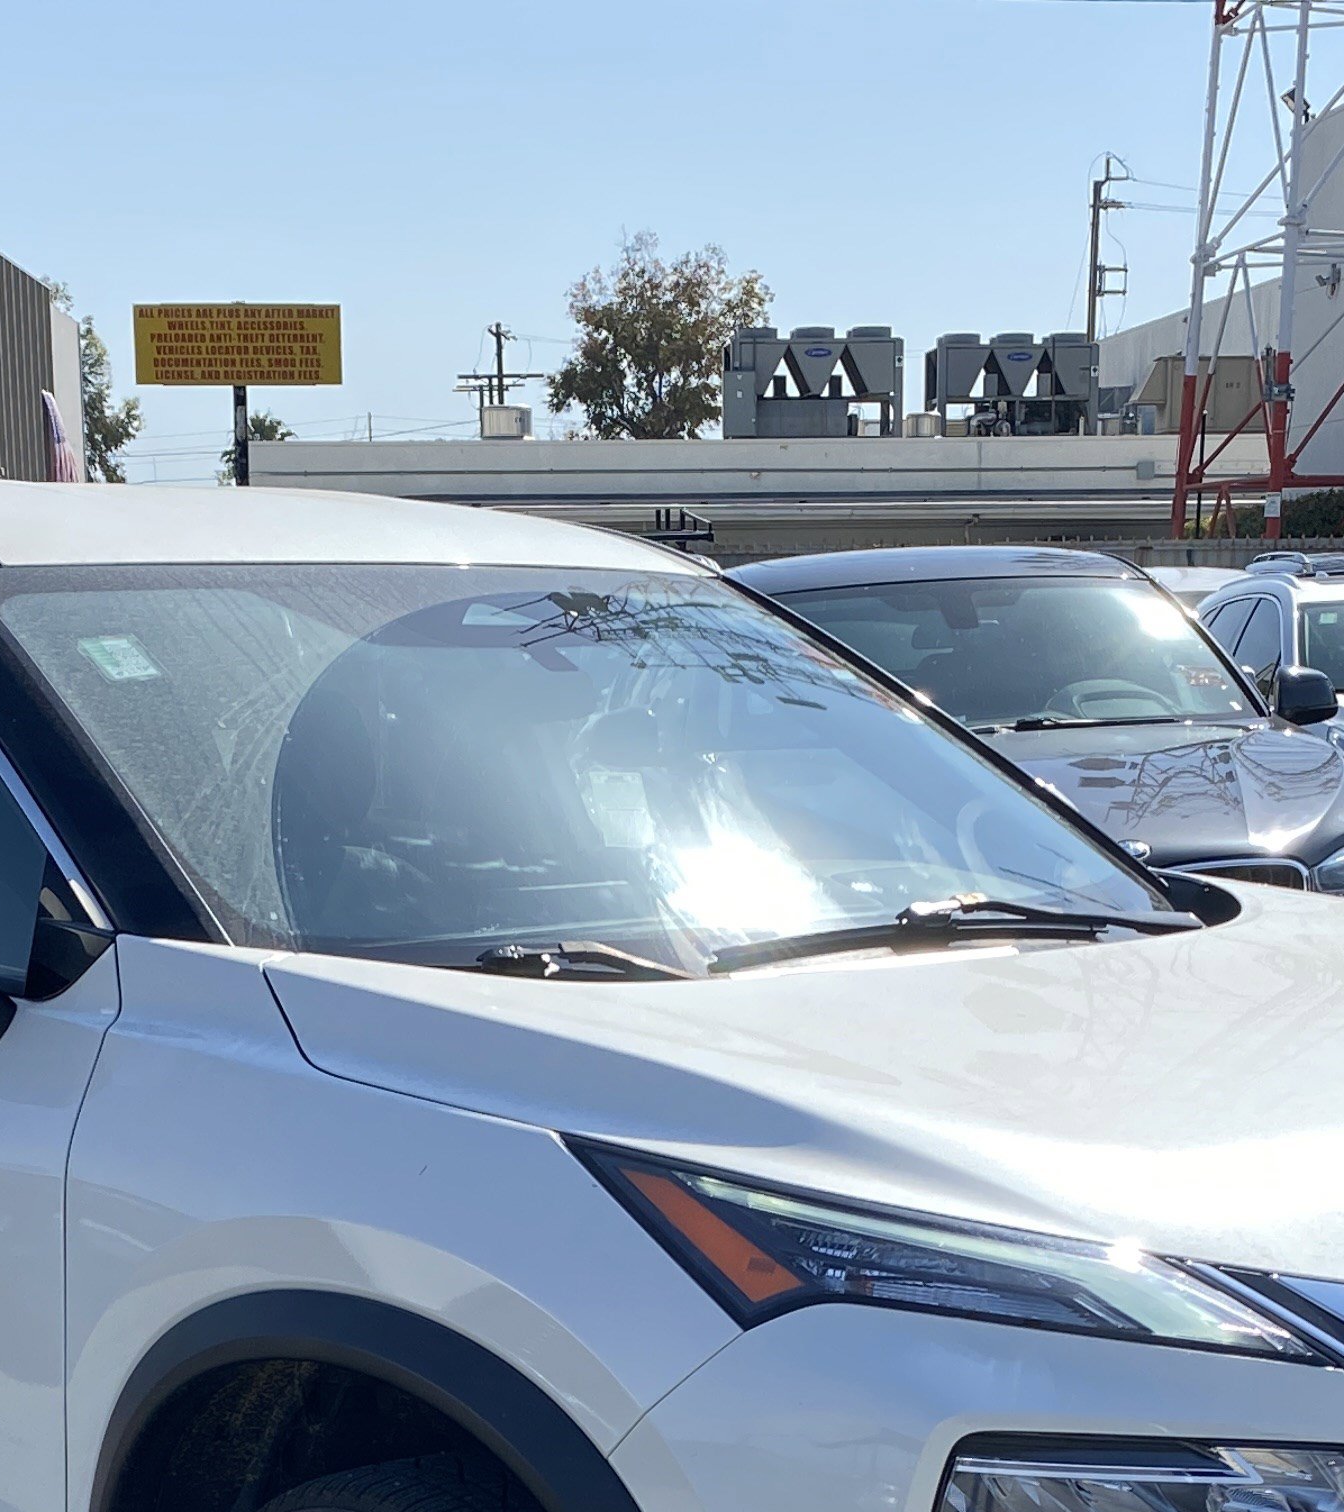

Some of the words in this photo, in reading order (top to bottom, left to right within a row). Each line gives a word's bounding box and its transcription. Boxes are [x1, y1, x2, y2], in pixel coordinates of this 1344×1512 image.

[138, 308, 155, 318] ALL
[157, 308, 193, 318] PRICES
[196, 308, 214, 318] ARE
[216, 308, 241, 318] PLUS
[244, 308, 262, 318] ANY
[264, 308, 294, 318] AFTER
[296, 308, 335, 318] MARKET
[150, 333, 207, 343] PRELOADED
[209, 333, 265, 343] ANTI-THEFT
[155, 345, 202, 356] VEHICLES
[205, 345, 249, 356] LOCATOR
[153, 357, 237, 368] DOCUMENTATION
[267, 357, 297, 368] SMOG
[200, 370, 221, 380] AND
[223, 370, 295, 380] REGISTRATION
